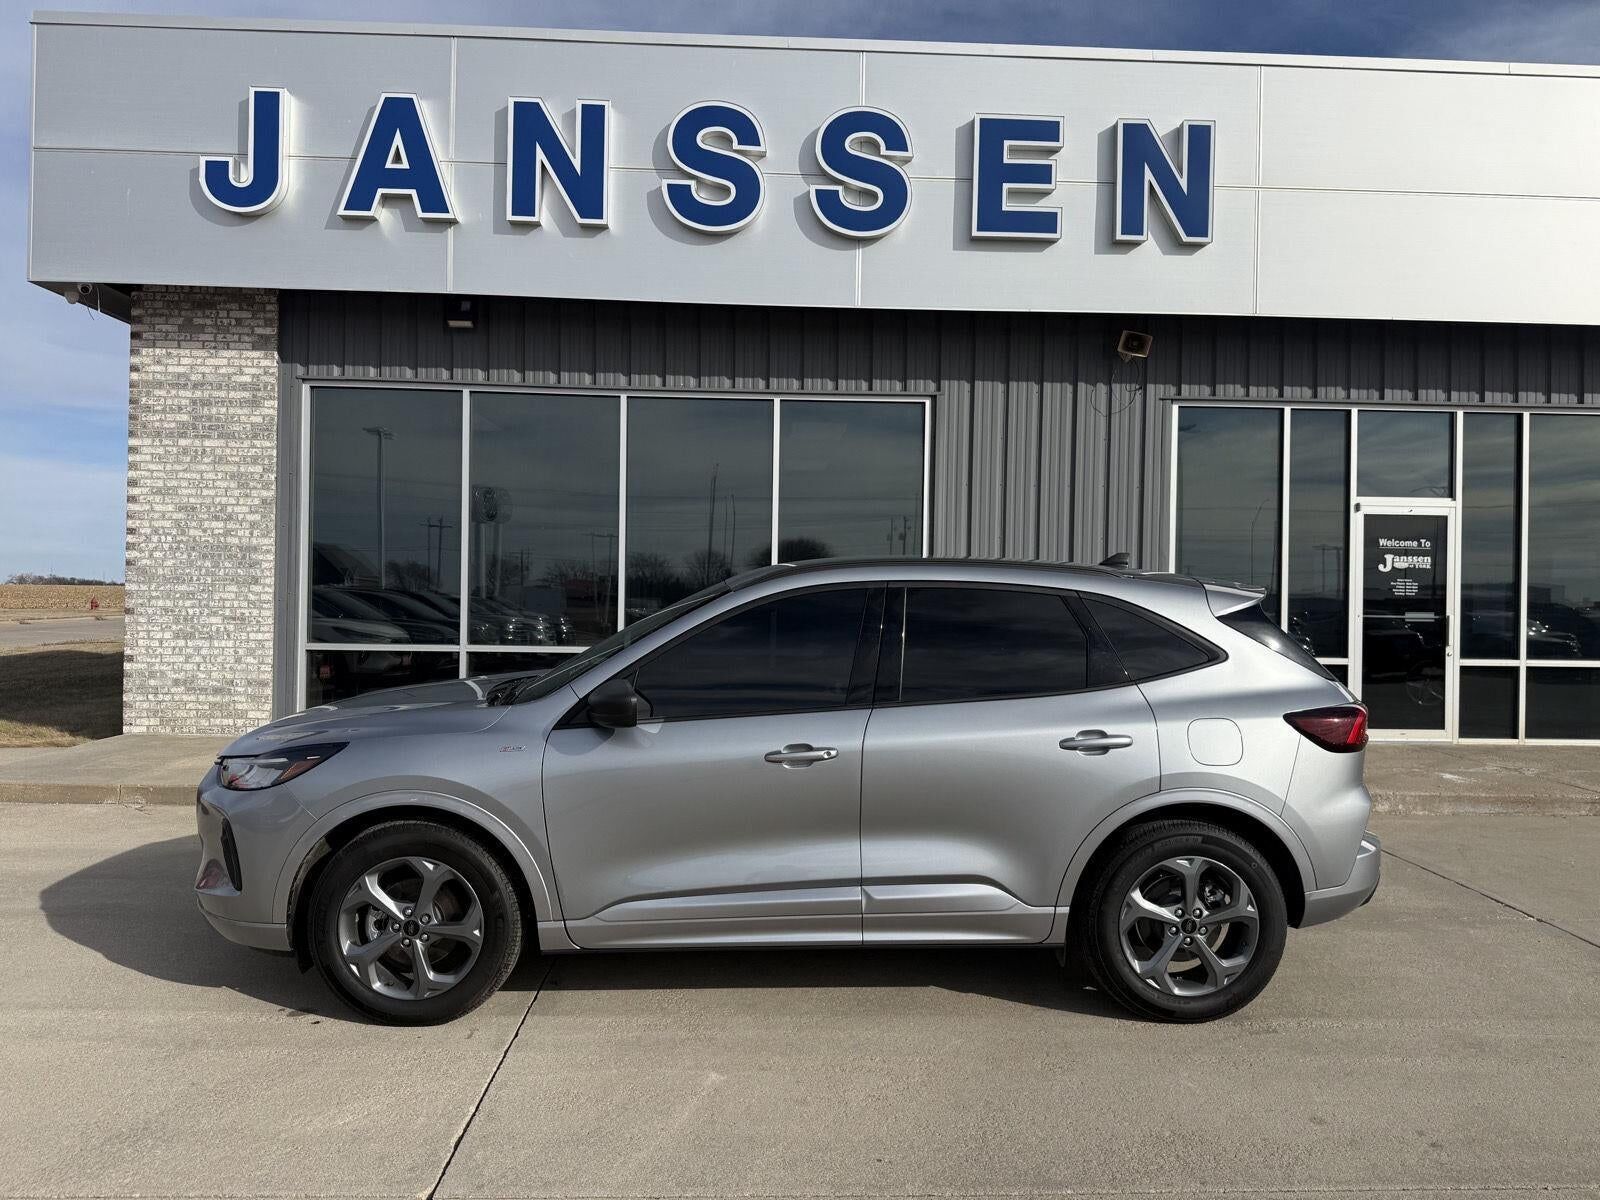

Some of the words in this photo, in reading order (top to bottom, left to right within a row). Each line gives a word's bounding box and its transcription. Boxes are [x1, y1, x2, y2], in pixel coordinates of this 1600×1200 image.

[198, 86, 1216, 244] JANSSEN
[1379, 538, 1418, 547] Welcome
[1420, 539, 1431, 548] To
[1378, 553, 1431, 572] Janssen
